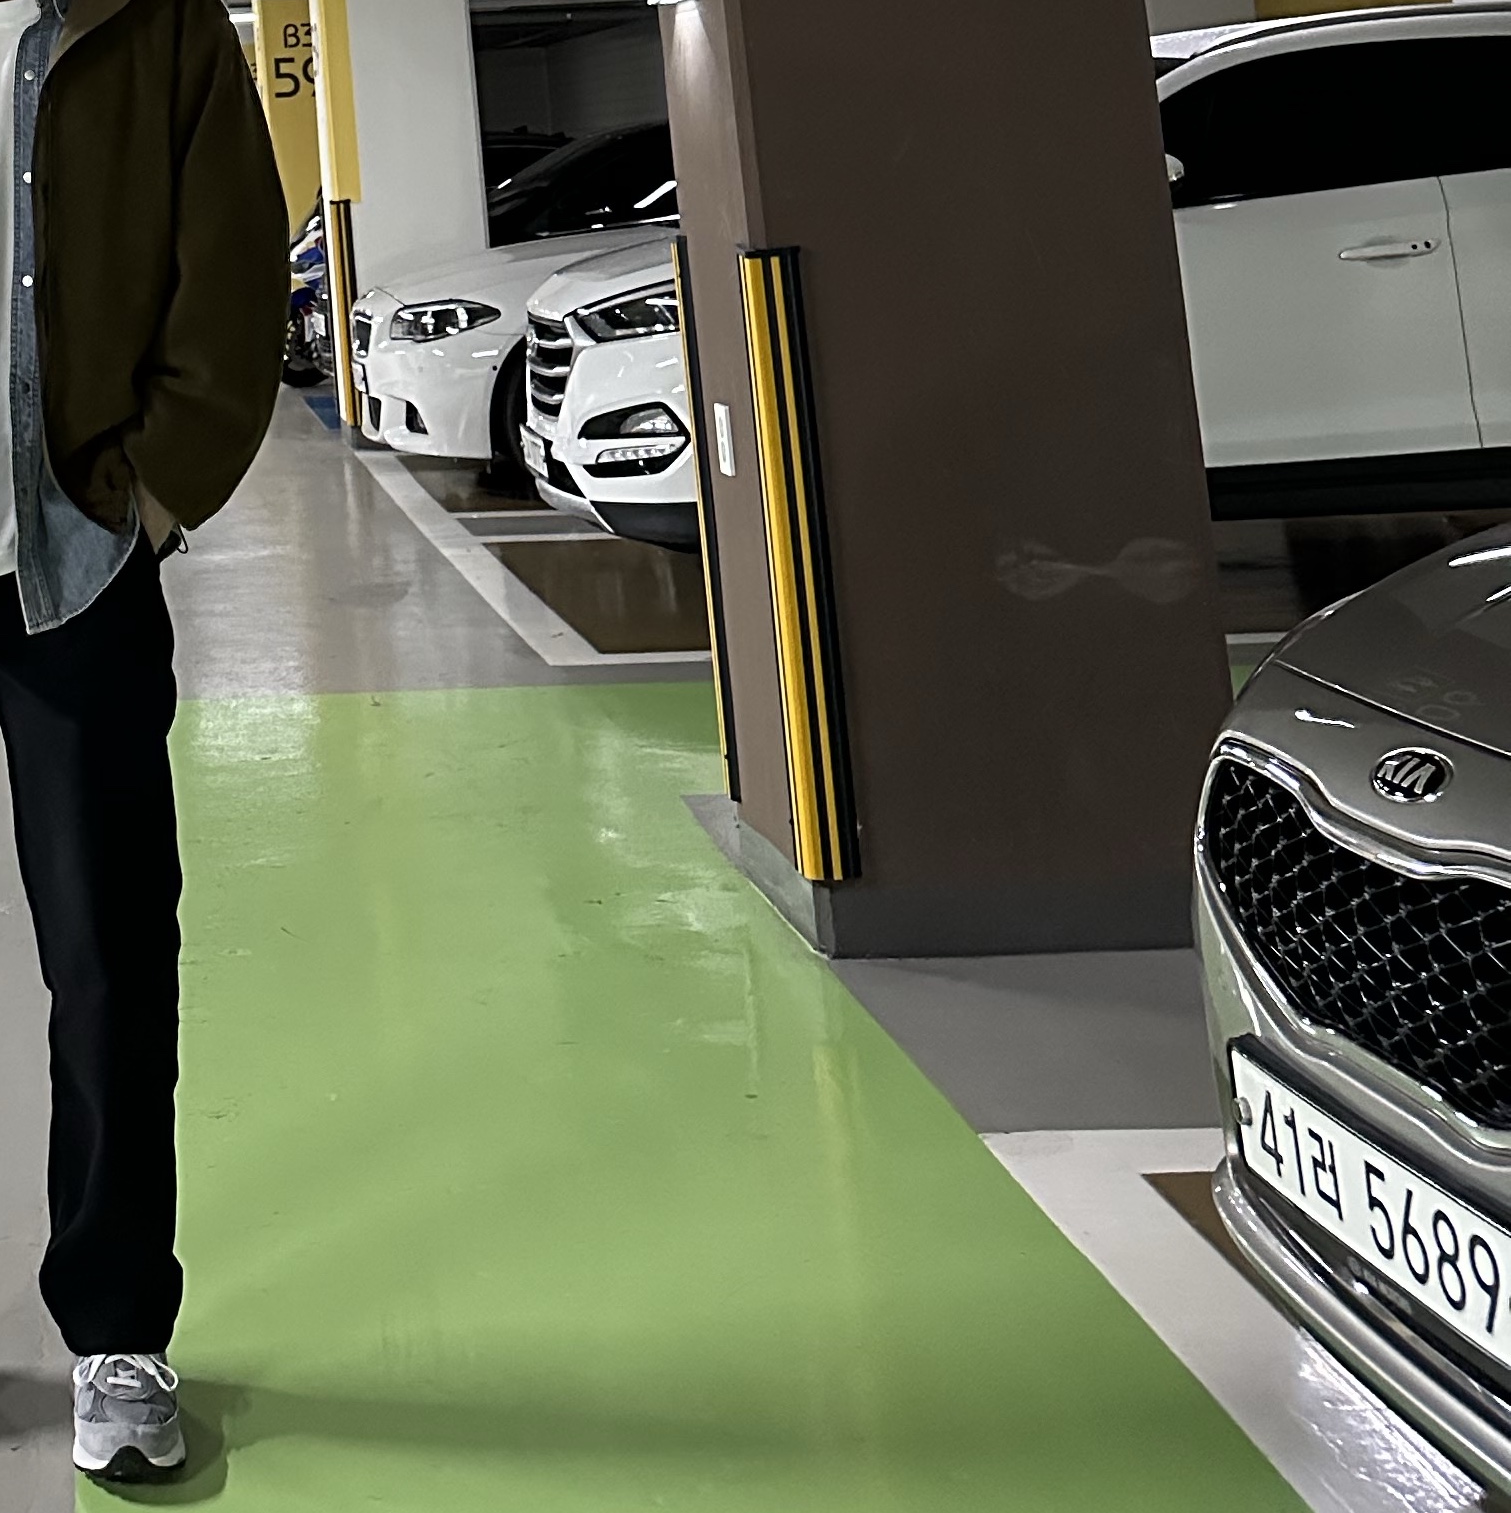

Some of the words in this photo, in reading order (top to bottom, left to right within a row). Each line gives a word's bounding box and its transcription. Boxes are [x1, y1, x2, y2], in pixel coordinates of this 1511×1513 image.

[1377, 754, 1437, 795] KIA
[1260, 1090, 1344, 1222] 41러
[1363, 1159, 1501, 1334] 5689
